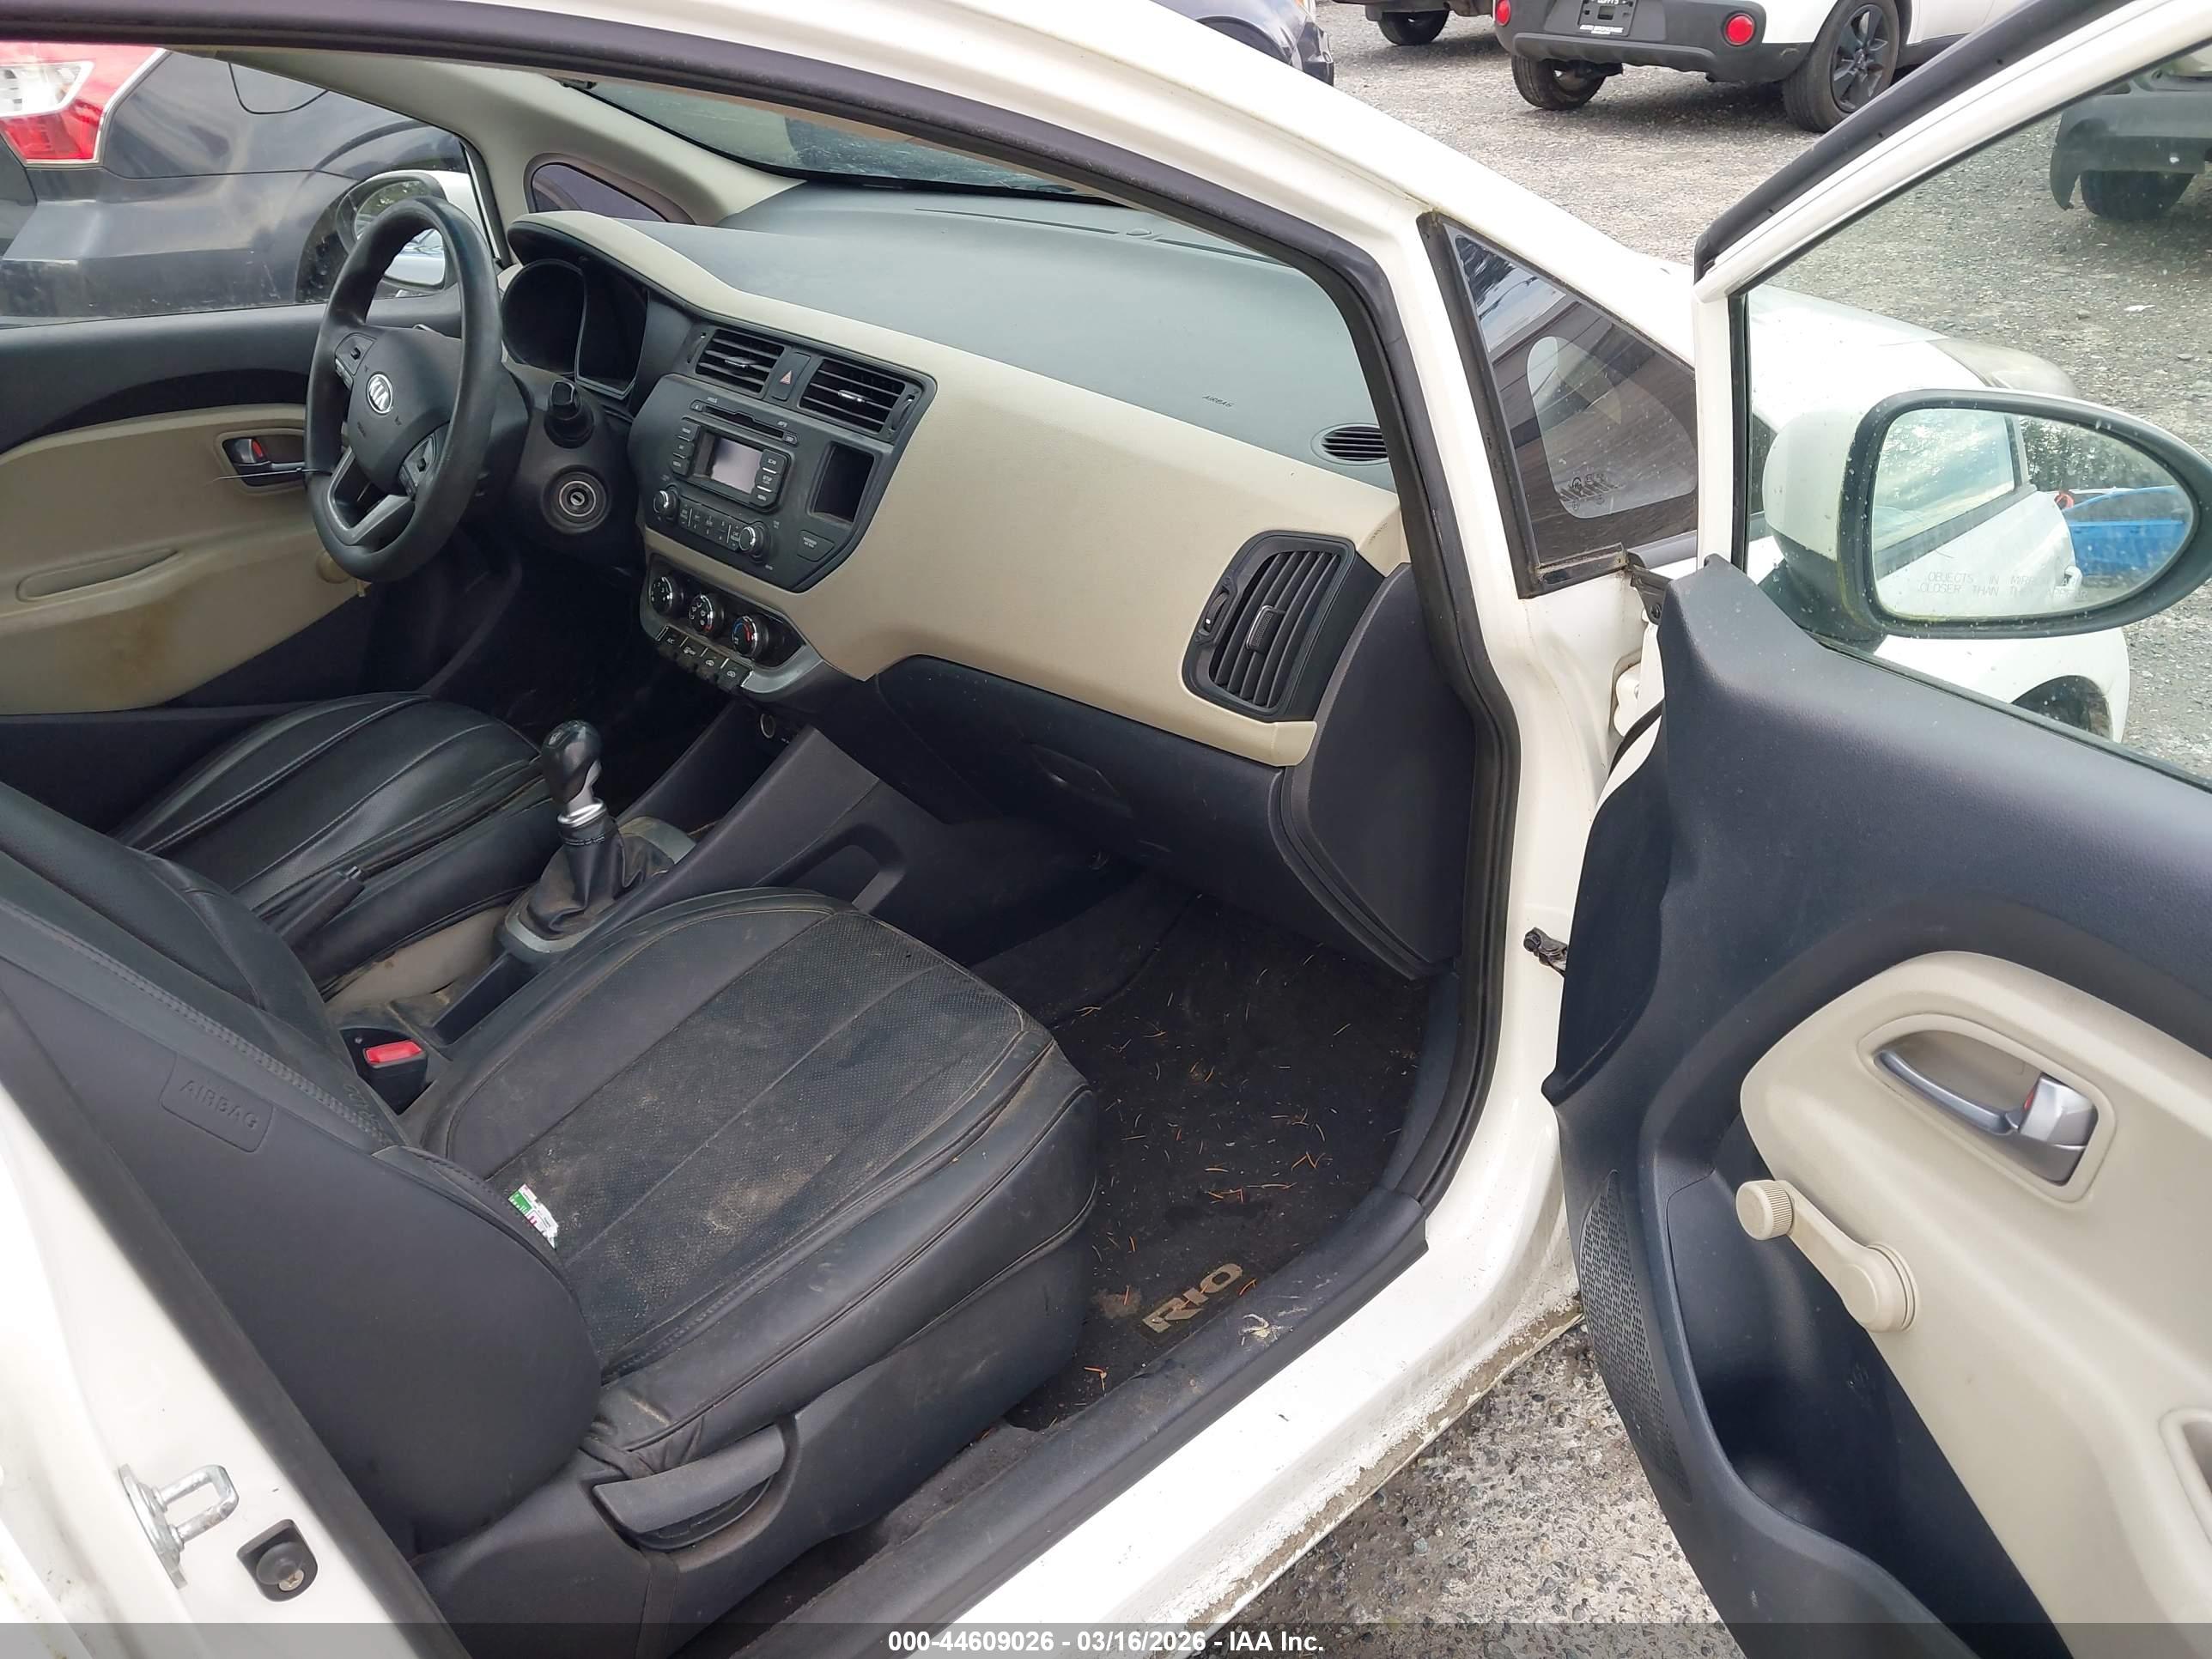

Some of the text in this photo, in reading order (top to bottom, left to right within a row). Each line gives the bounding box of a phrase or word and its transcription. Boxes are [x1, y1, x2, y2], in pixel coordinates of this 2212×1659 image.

[368, 375, 389, 411] KIA
[1919, 582, 1962, 594] CLOSER
[1972, 585, 2000, 597] THAN
[1928, 572, 1973, 584] OBJECTS
[1988, 576, 2000, 585] IN
[179, 1079, 258, 1129] AIRBAG
[1141, 1263, 1243, 1334] RIO
